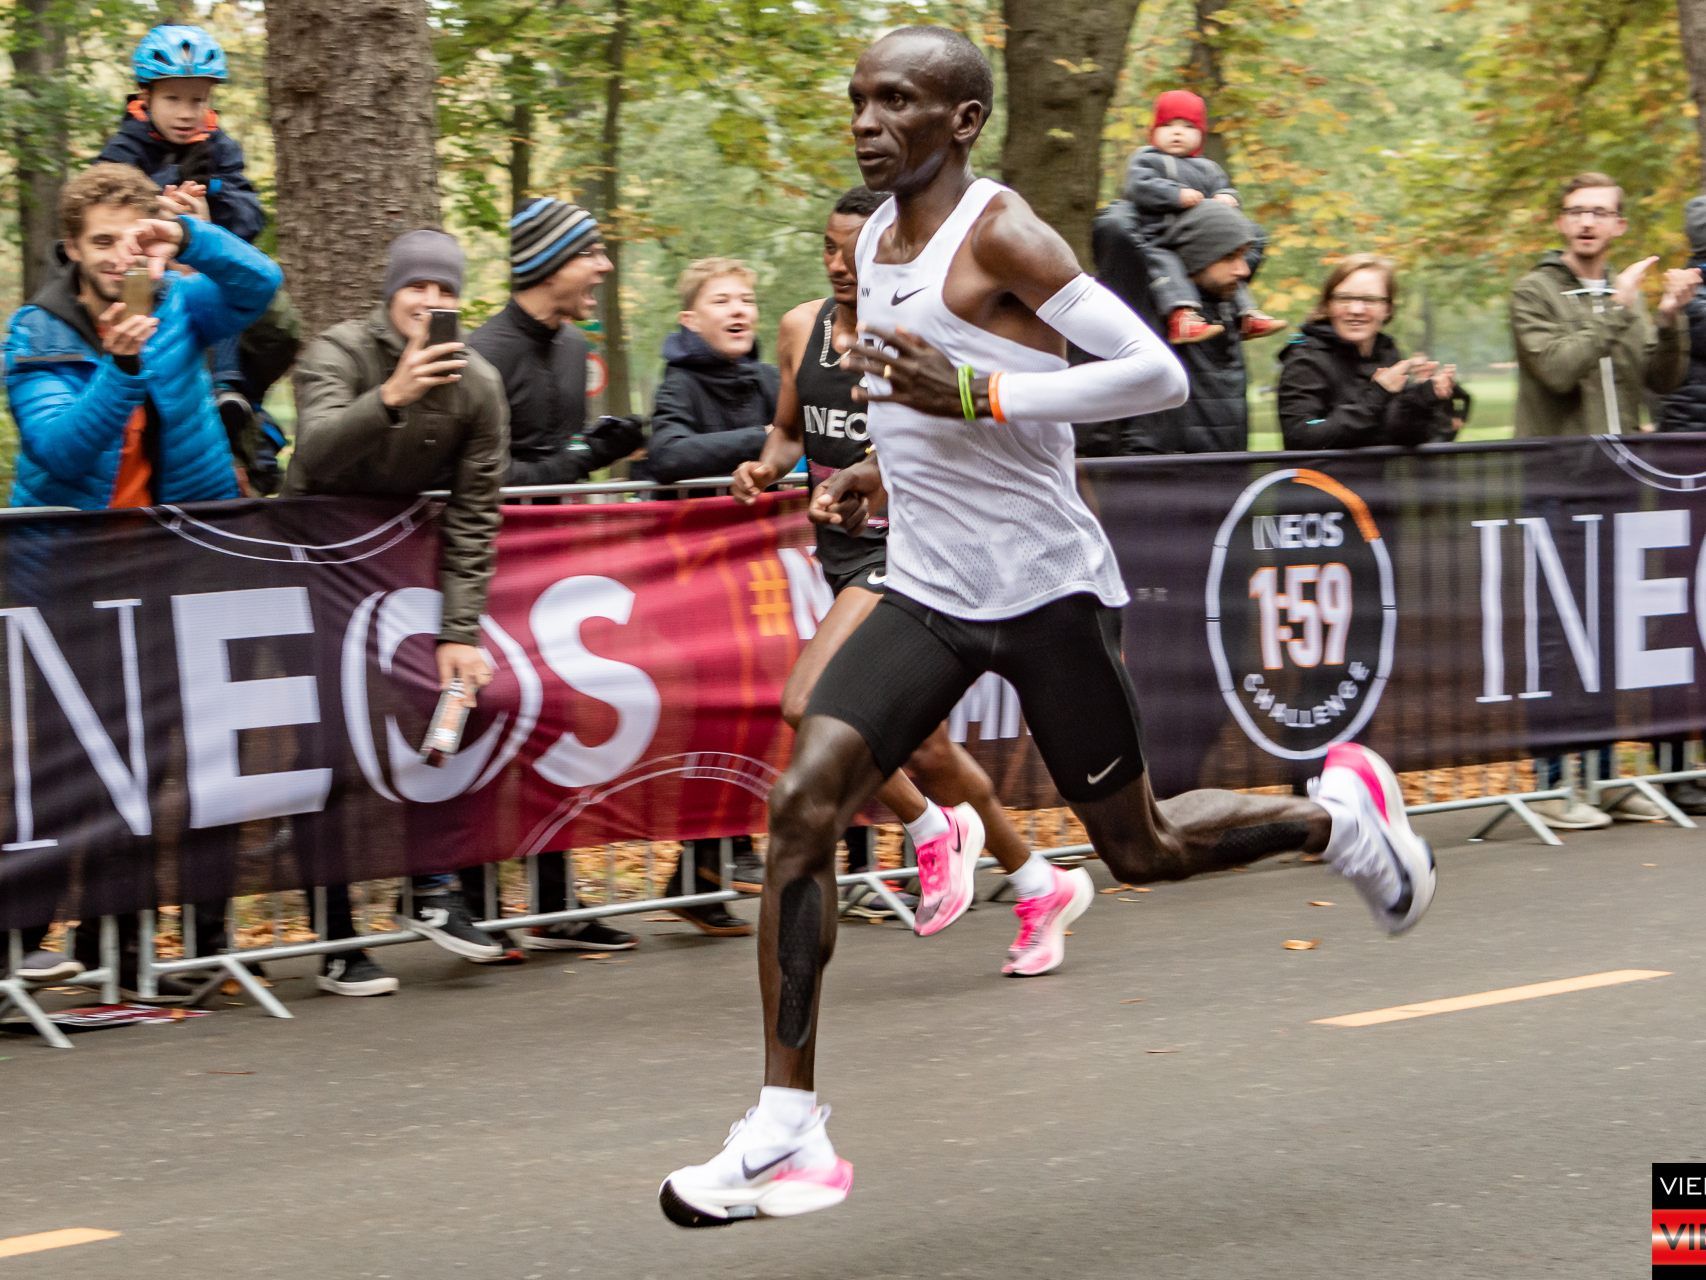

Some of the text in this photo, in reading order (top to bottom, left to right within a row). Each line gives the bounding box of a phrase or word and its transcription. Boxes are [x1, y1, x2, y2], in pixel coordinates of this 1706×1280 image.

[803, 404, 870, 441] INEO
[1253, 512, 1345, 550] INEOS
[1248, 562, 1353, 670] 1:59
[1471, 509, 1706, 703] INE
[1243, 661, 1370, 728] CHALLENGE
